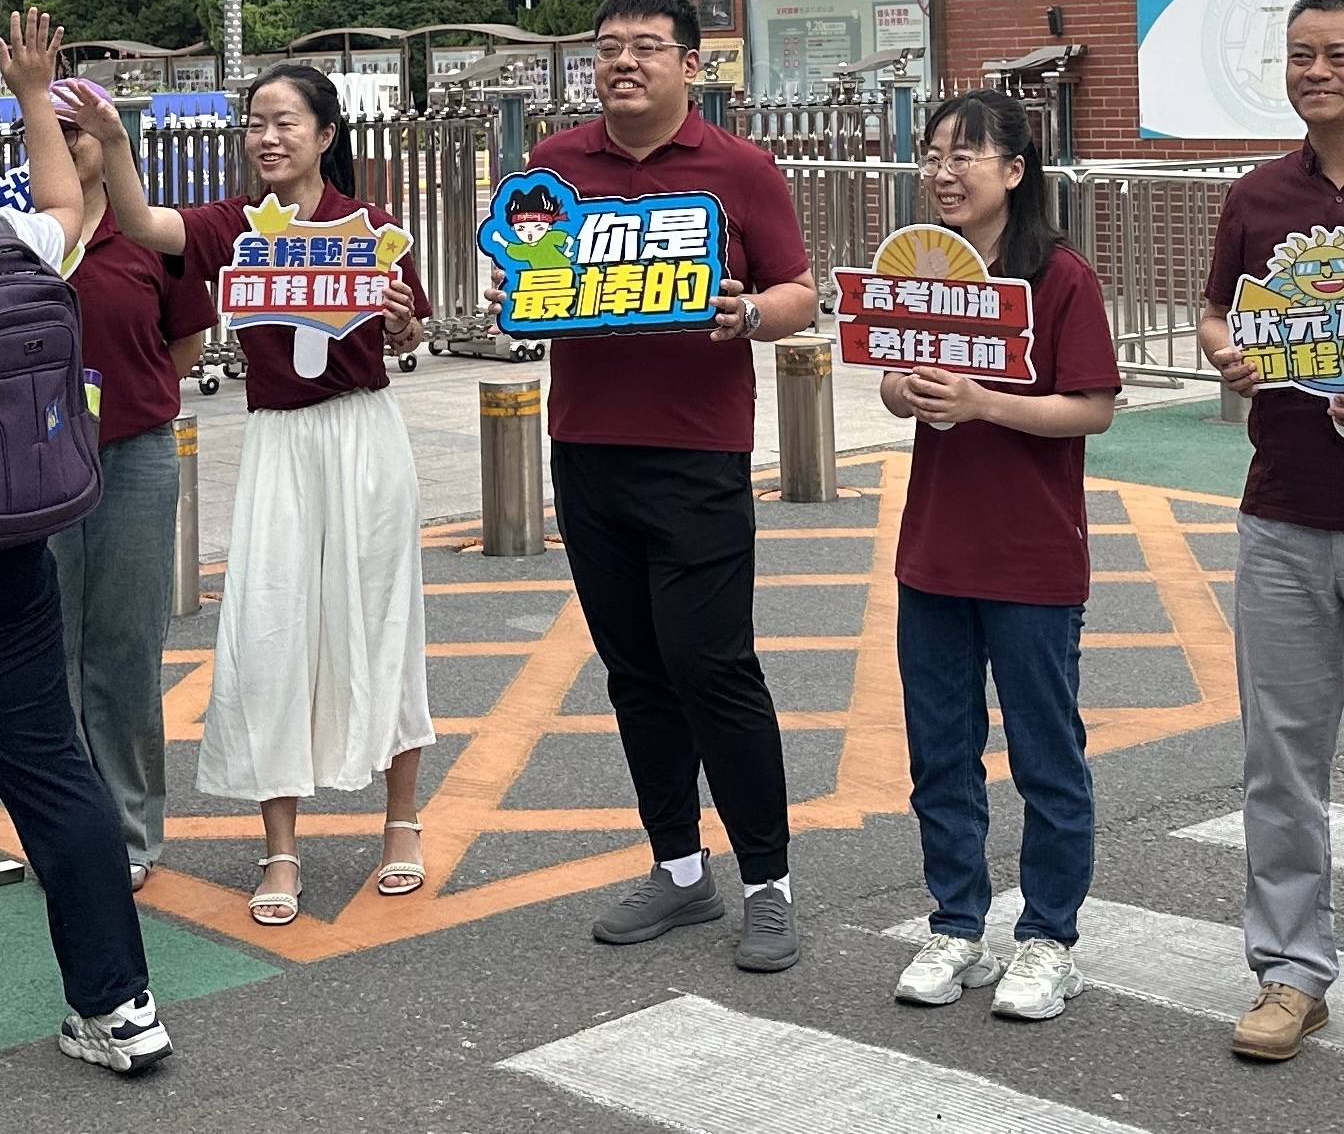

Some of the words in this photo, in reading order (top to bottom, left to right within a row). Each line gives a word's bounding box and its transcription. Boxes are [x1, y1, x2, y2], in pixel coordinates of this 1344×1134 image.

[237, 236, 378, 267] 金榜题名
[575, 207, 708, 265] 你是
[229, 274, 390, 307] 前程似锦
[511, 260, 710, 320] 最棒的
[861, 277, 1001, 320] 高考加油
[868, 326, 1006, 371] 勇往直前
